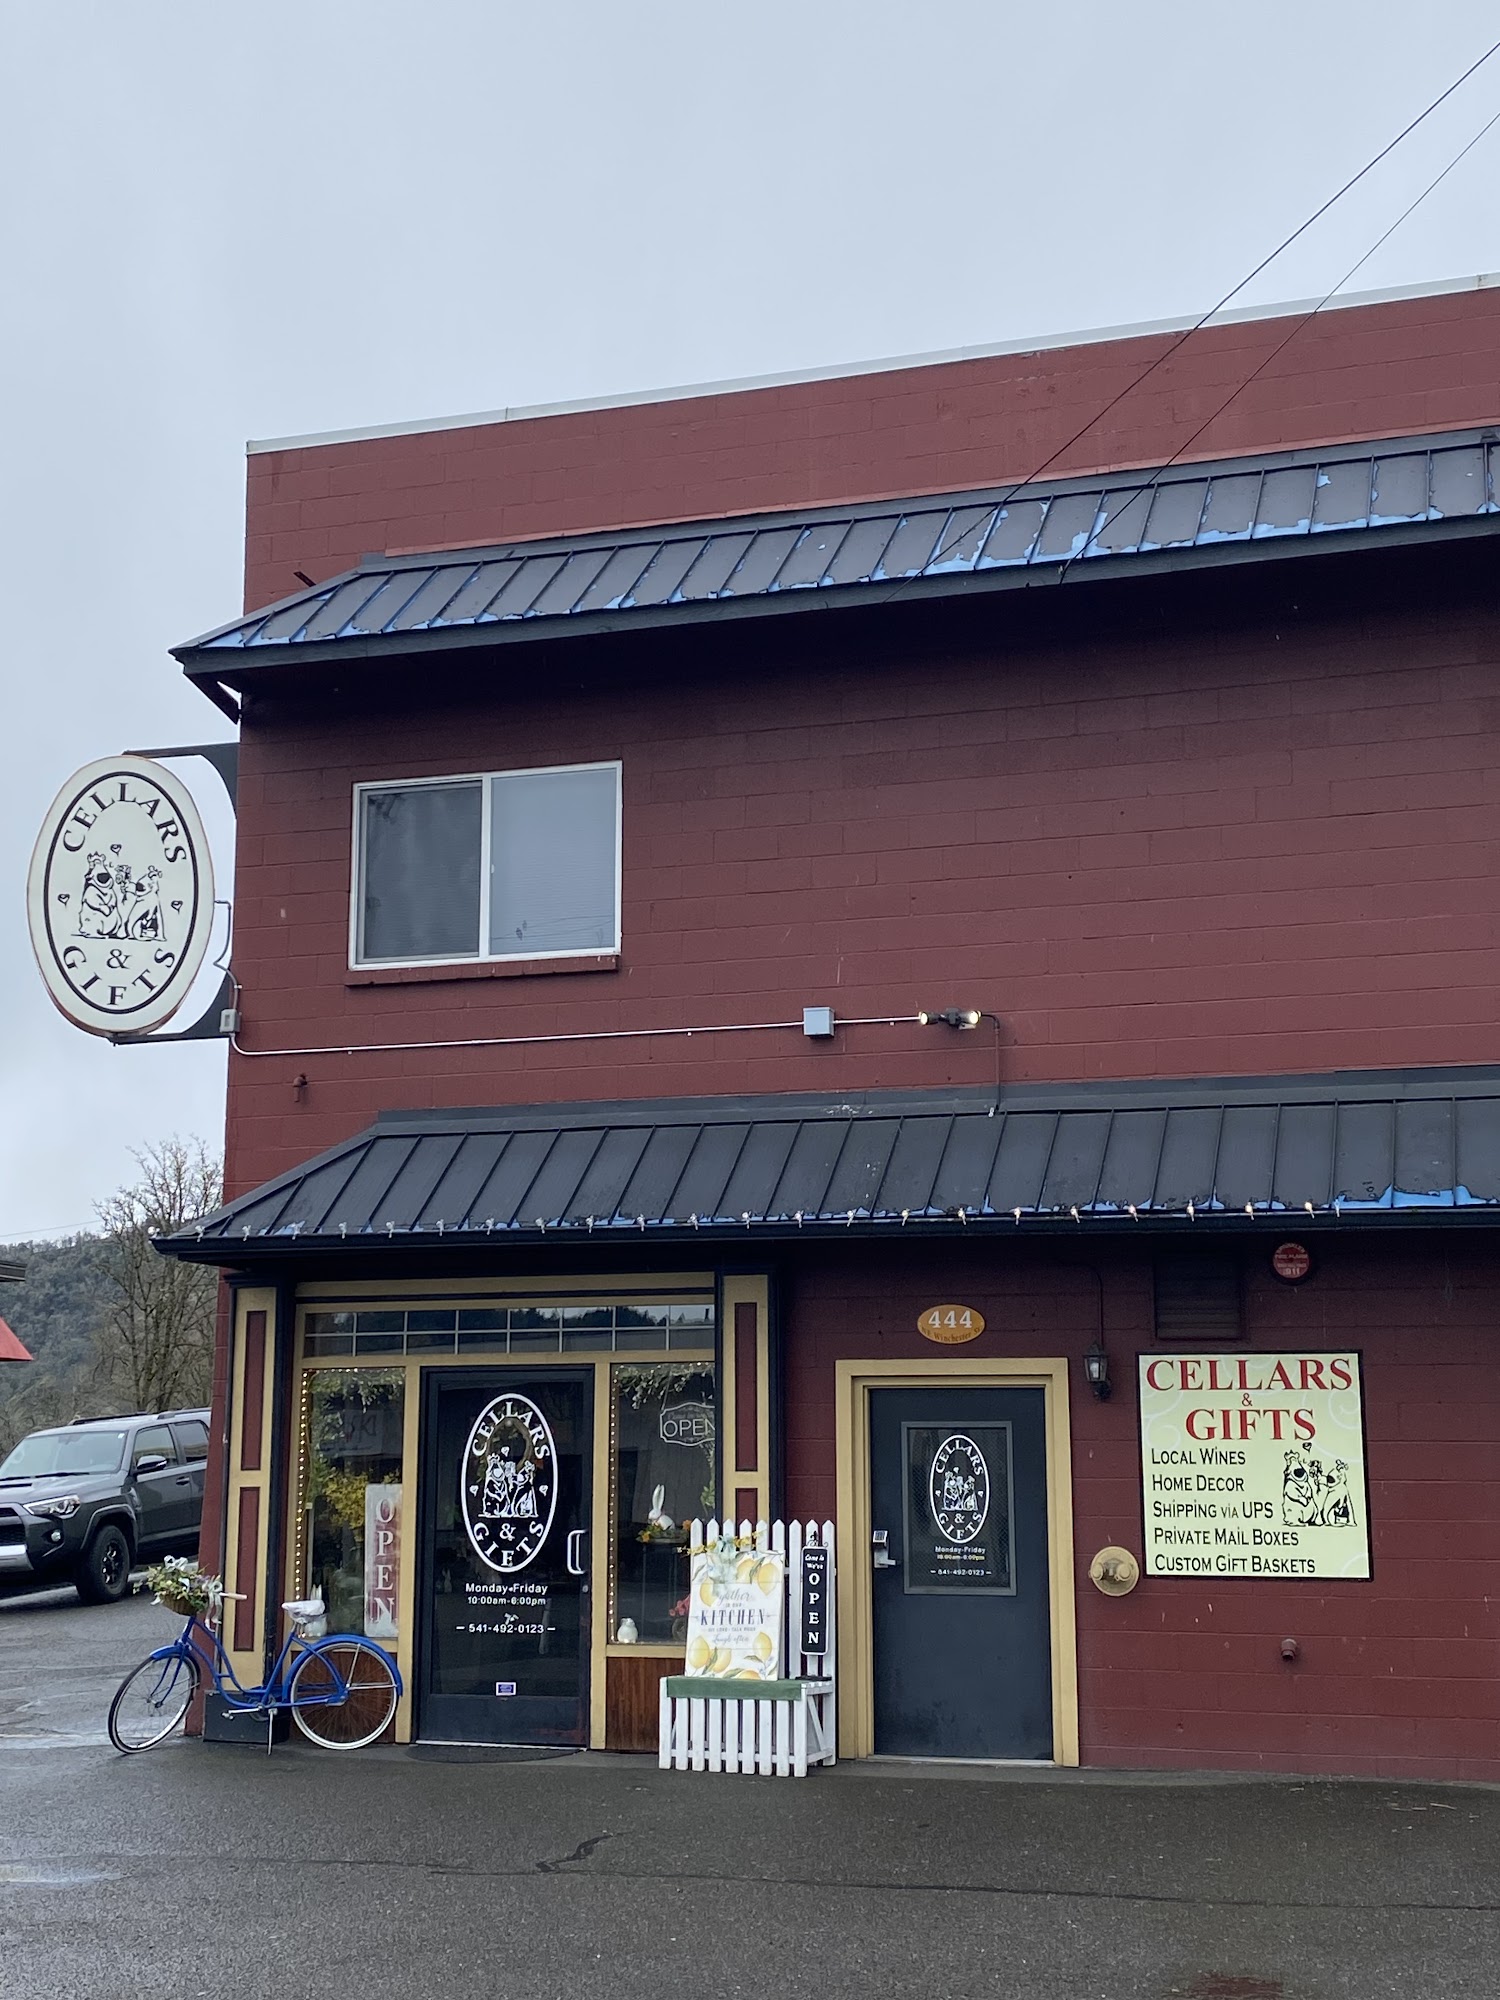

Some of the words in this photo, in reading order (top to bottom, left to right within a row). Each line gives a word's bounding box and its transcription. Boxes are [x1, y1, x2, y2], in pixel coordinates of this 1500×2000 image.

[63, 782, 187, 863] CELLARS
[106, 949, 132, 969] &
[63, 945, 176, 1006] GIFTS
[928, 1310, 973, 1328] 444
[1146, 1358, 1353, 1391] CELLARS
[1241, 1393, 1253, 1407] &
[472, 1401, 550, 1460] CELLARS
[663, 1418, 716, 1437] OPEN
[1185, 1408, 1316, 1441] GIFTS
[935, 1440, 984, 1476] CELLARS
[954, 1513, 965, 1524] &
[1242, 1501, 1274, 1519] UPS
[499, 1522, 517, 1541] &
[938, 1511, 982, 1540] GIFTS
[473, 1520, 544, 1567] GIFTS
[373, 1497, 398, 1624] OPEN
[805, 1553, 818, 1562] Come
[701, 1608, 765, 1626] KITCHEN
[808, 1572, 820, 1644] OPEN
[468, 1623, 545, 1634] 541-492-0123
